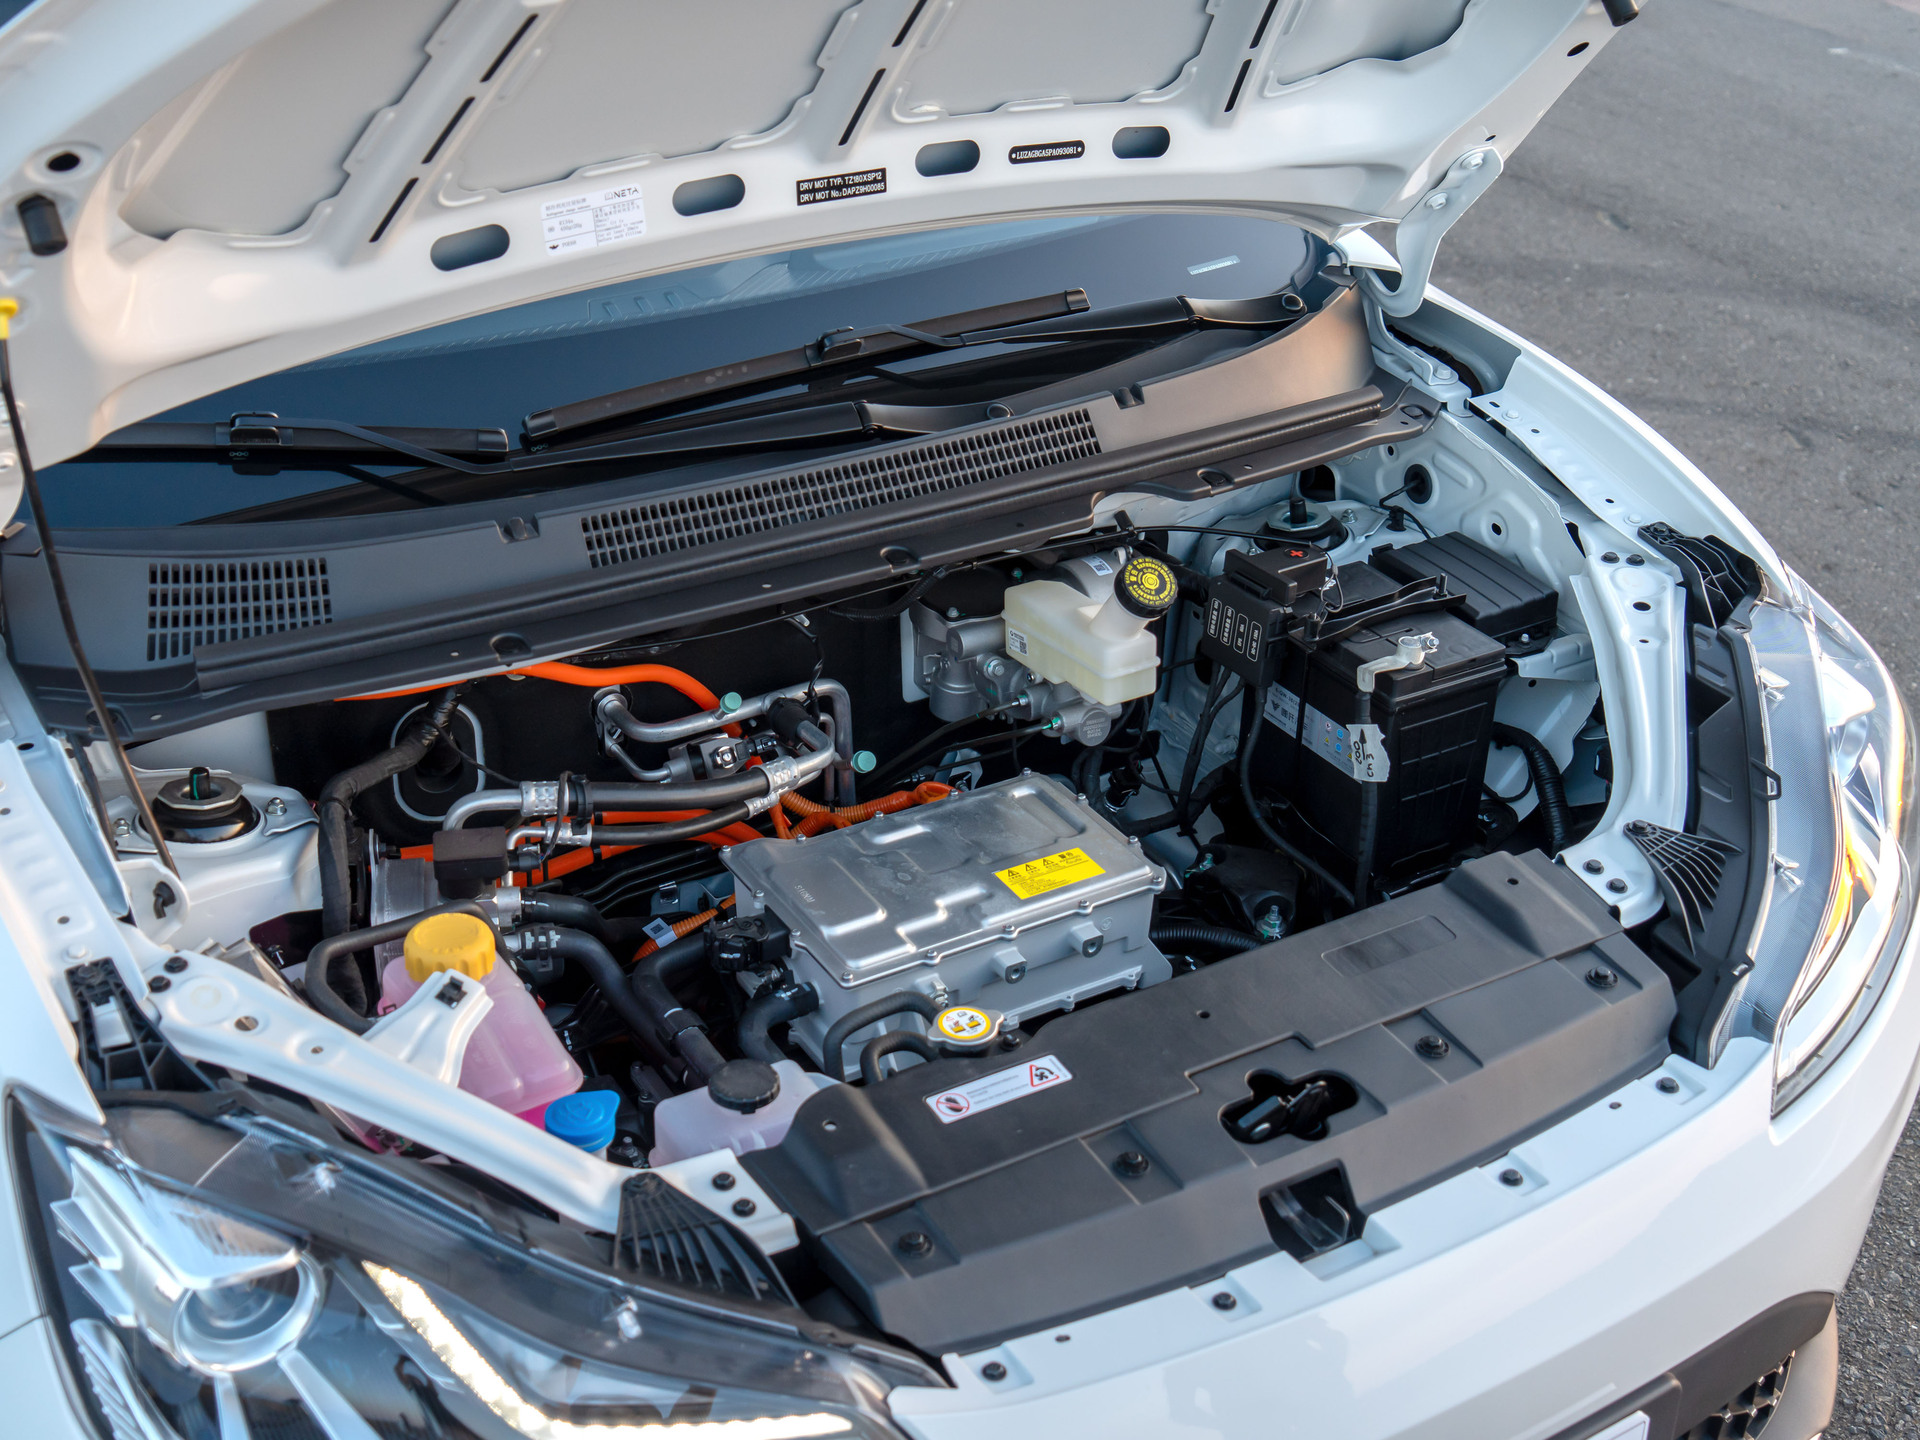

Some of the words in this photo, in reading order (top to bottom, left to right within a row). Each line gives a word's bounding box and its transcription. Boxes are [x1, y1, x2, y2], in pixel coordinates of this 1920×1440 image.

[799, 182, 814, 191] DRV
[814, 179, 828, 189] MOT
[613, 187, 639, 199] NETA
[800, 193, 814, 203] DRV
[815, 190, 829, 201] MOT
